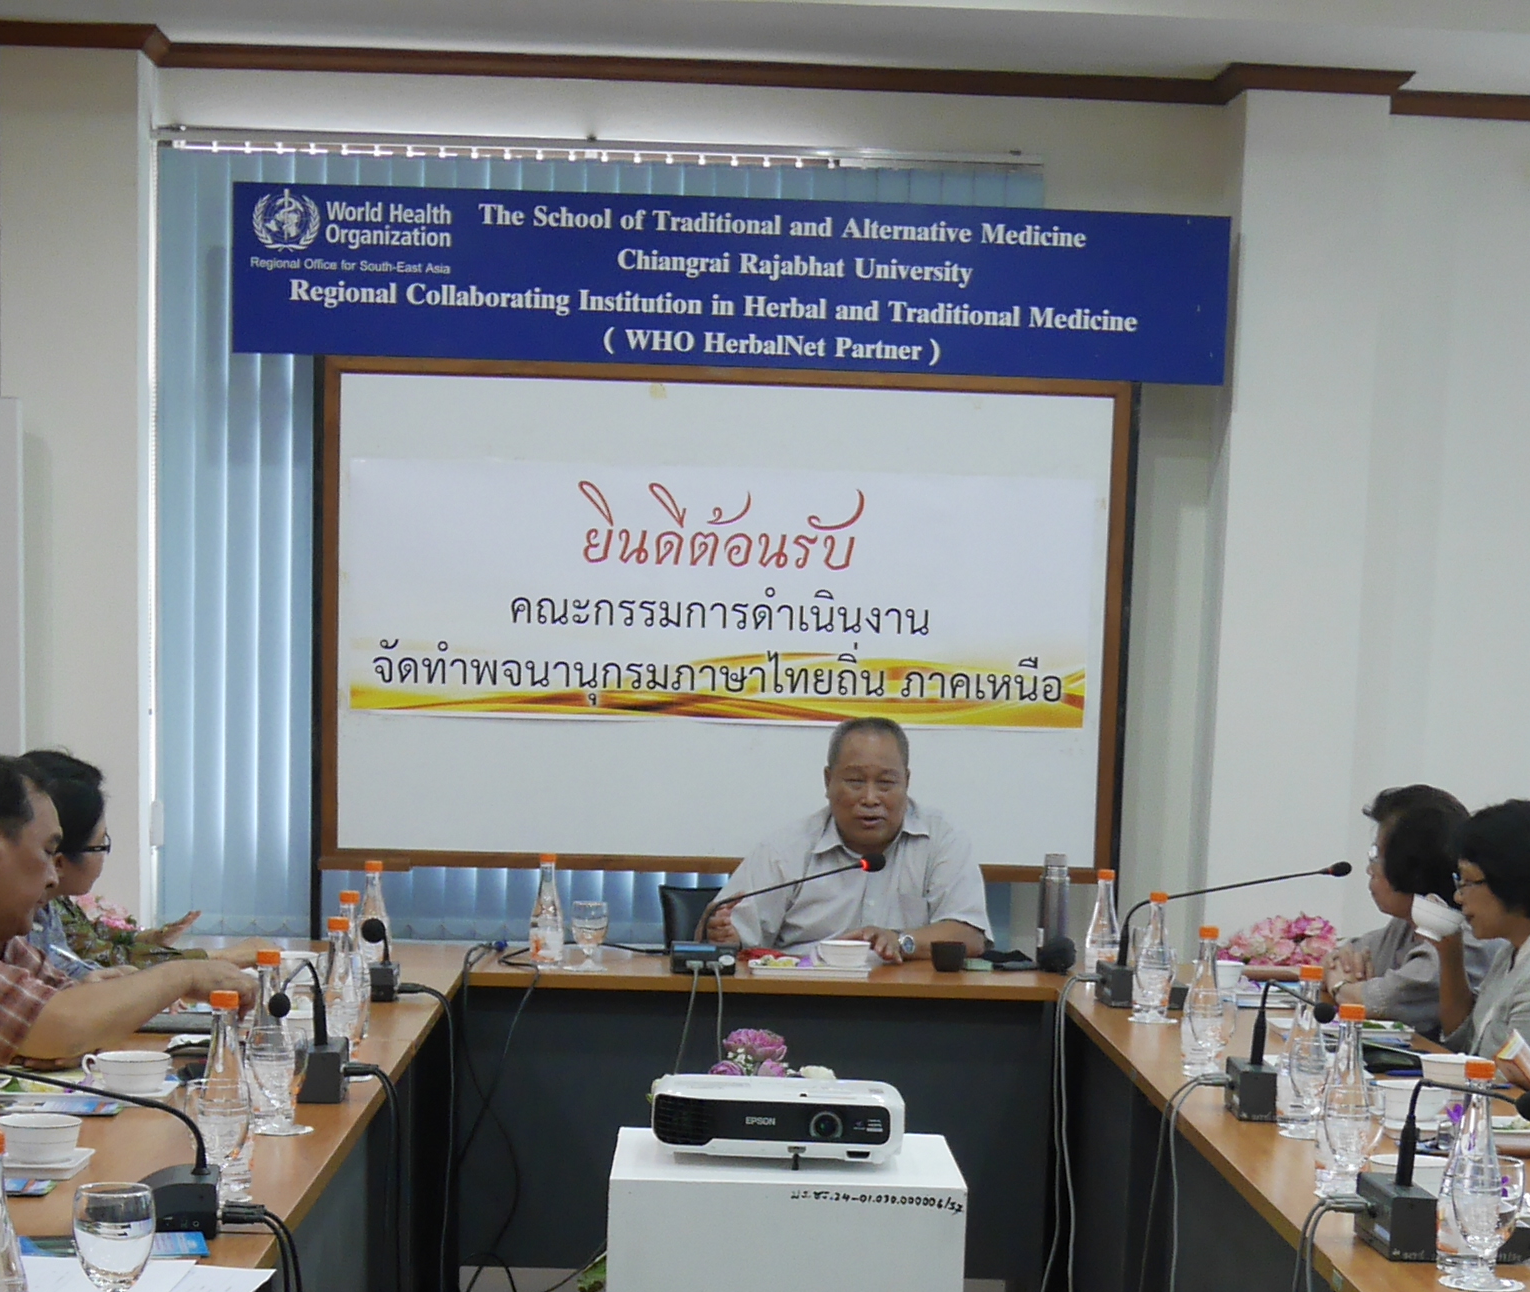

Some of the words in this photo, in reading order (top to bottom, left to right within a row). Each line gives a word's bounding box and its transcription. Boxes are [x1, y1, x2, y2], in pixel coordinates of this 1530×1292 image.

[326, 200, 383, 223] World
[389, 202, 453, 225] Health
[478, 202, 525, 227] The
[532, 204, 613, 230] School
[620, 208, 647, 232] of
[652, 209, 782, 237] Traditional
[789, 216, 833, 239] and
[841, 217, 973, 244] Alternative
[980, 222, 1087, 249] Medicine
[325, 224, 453, 250] Organization
[250, 256, 301, 271] Regional
[303, 257, 338, 271] Office
[340, 259, 356, 271] for
[359, 260, 422, 274] South-East
[425, 262, 451, 275] Asia
[617, 248, 731, 278] Chiangrai
[739, 252, 845, 281] Rajabhat
[854, 257, 974, 289] University
[289, 278, 397, 308] Regional
[405, 281, 570, 316] Collaborating
[579, 288, 703, 315] Institution
[711, 293, 734, 316] in
[742, 295, 827, 320] Herbal
[834, 300, 880, 322] and
[887, 300, 1021, 327] Traditional
[1028, 305, 1139, 332] Medicine
[603, 326, 616, 355] (
[625, 328, 696, 352] WHO
[703, 331, 826, 357] HerbalNet
[834, 336, 923, 361] Partner
[928, 338, 942, 366] )
[577, 480, 866, 571] ยินดีต้อนรับ
[511, 586, 930, 636] คณะกรรมการดำเนินงาน
[372, 638, 885, 706] จัดทำพจนานุกรมภาษาไทยถิ่น
[900, 656, 1063, 702] ภาคเหนือ
[745, 1116, 776, 1126] EPSON
